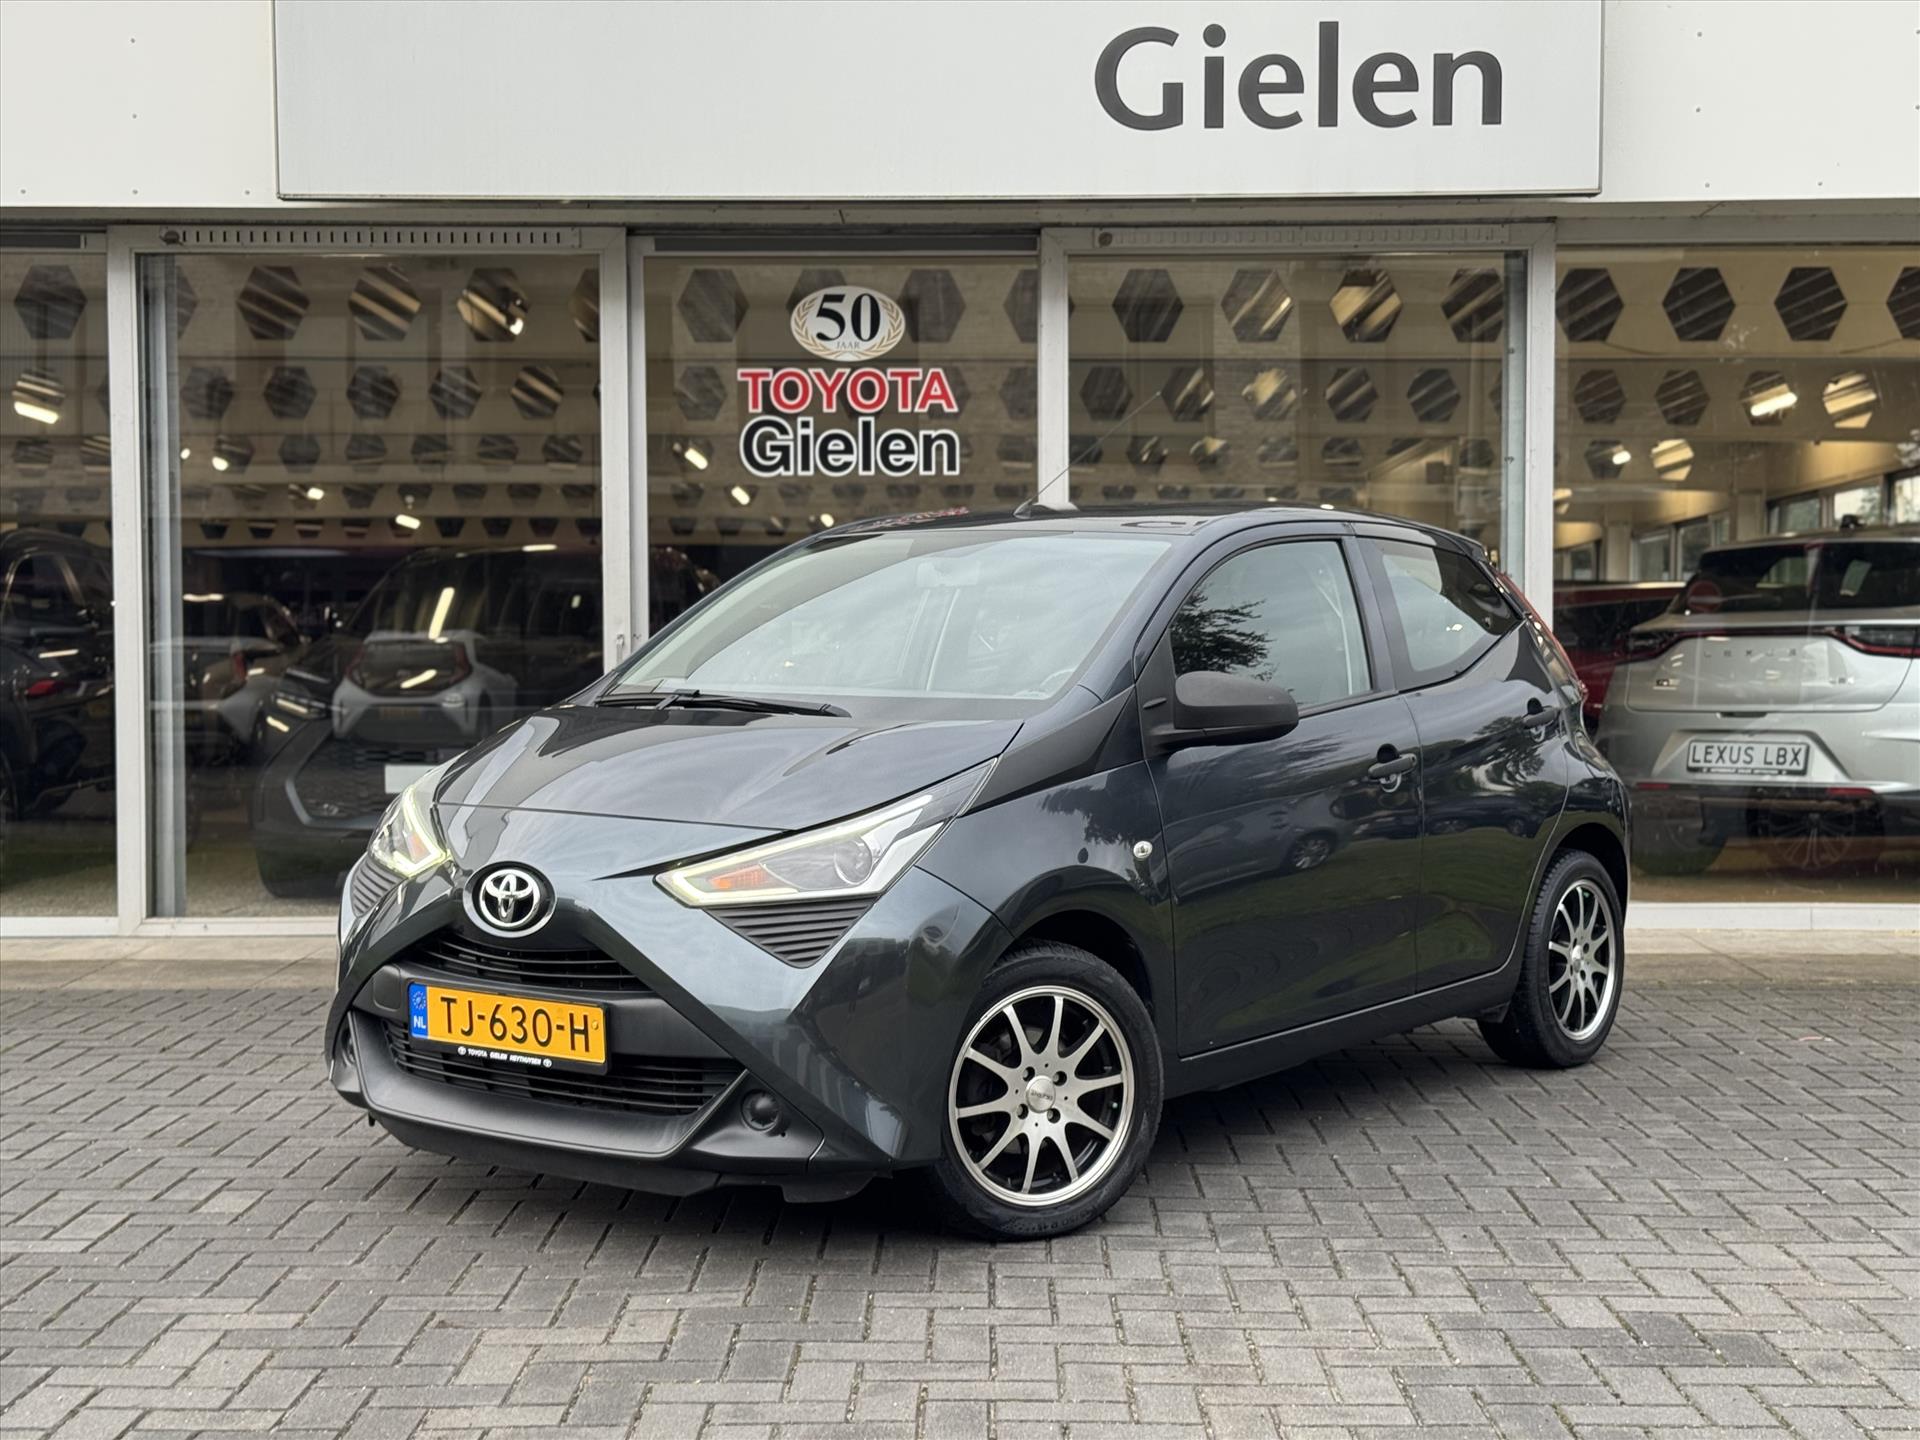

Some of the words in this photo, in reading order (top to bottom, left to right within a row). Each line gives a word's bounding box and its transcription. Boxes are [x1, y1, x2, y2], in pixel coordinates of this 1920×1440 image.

[1094, 21, 1502, 131] Gielen
[816, 293, 880, 342] 50
[836, 341, 860, 350] JAAR
[738, 369, 958, 413] TOYOTA
[740, 416, 960, 477] Gielen
[1691, 745, 1755, 765] LEXUS
[1763, 747, 1802, 767] LBX
[413, 1015, 427, 1029] NL
[440, 996, 590, 1053] TJ-630-H
[467, 1048, 488, 1058] TOYOTA
